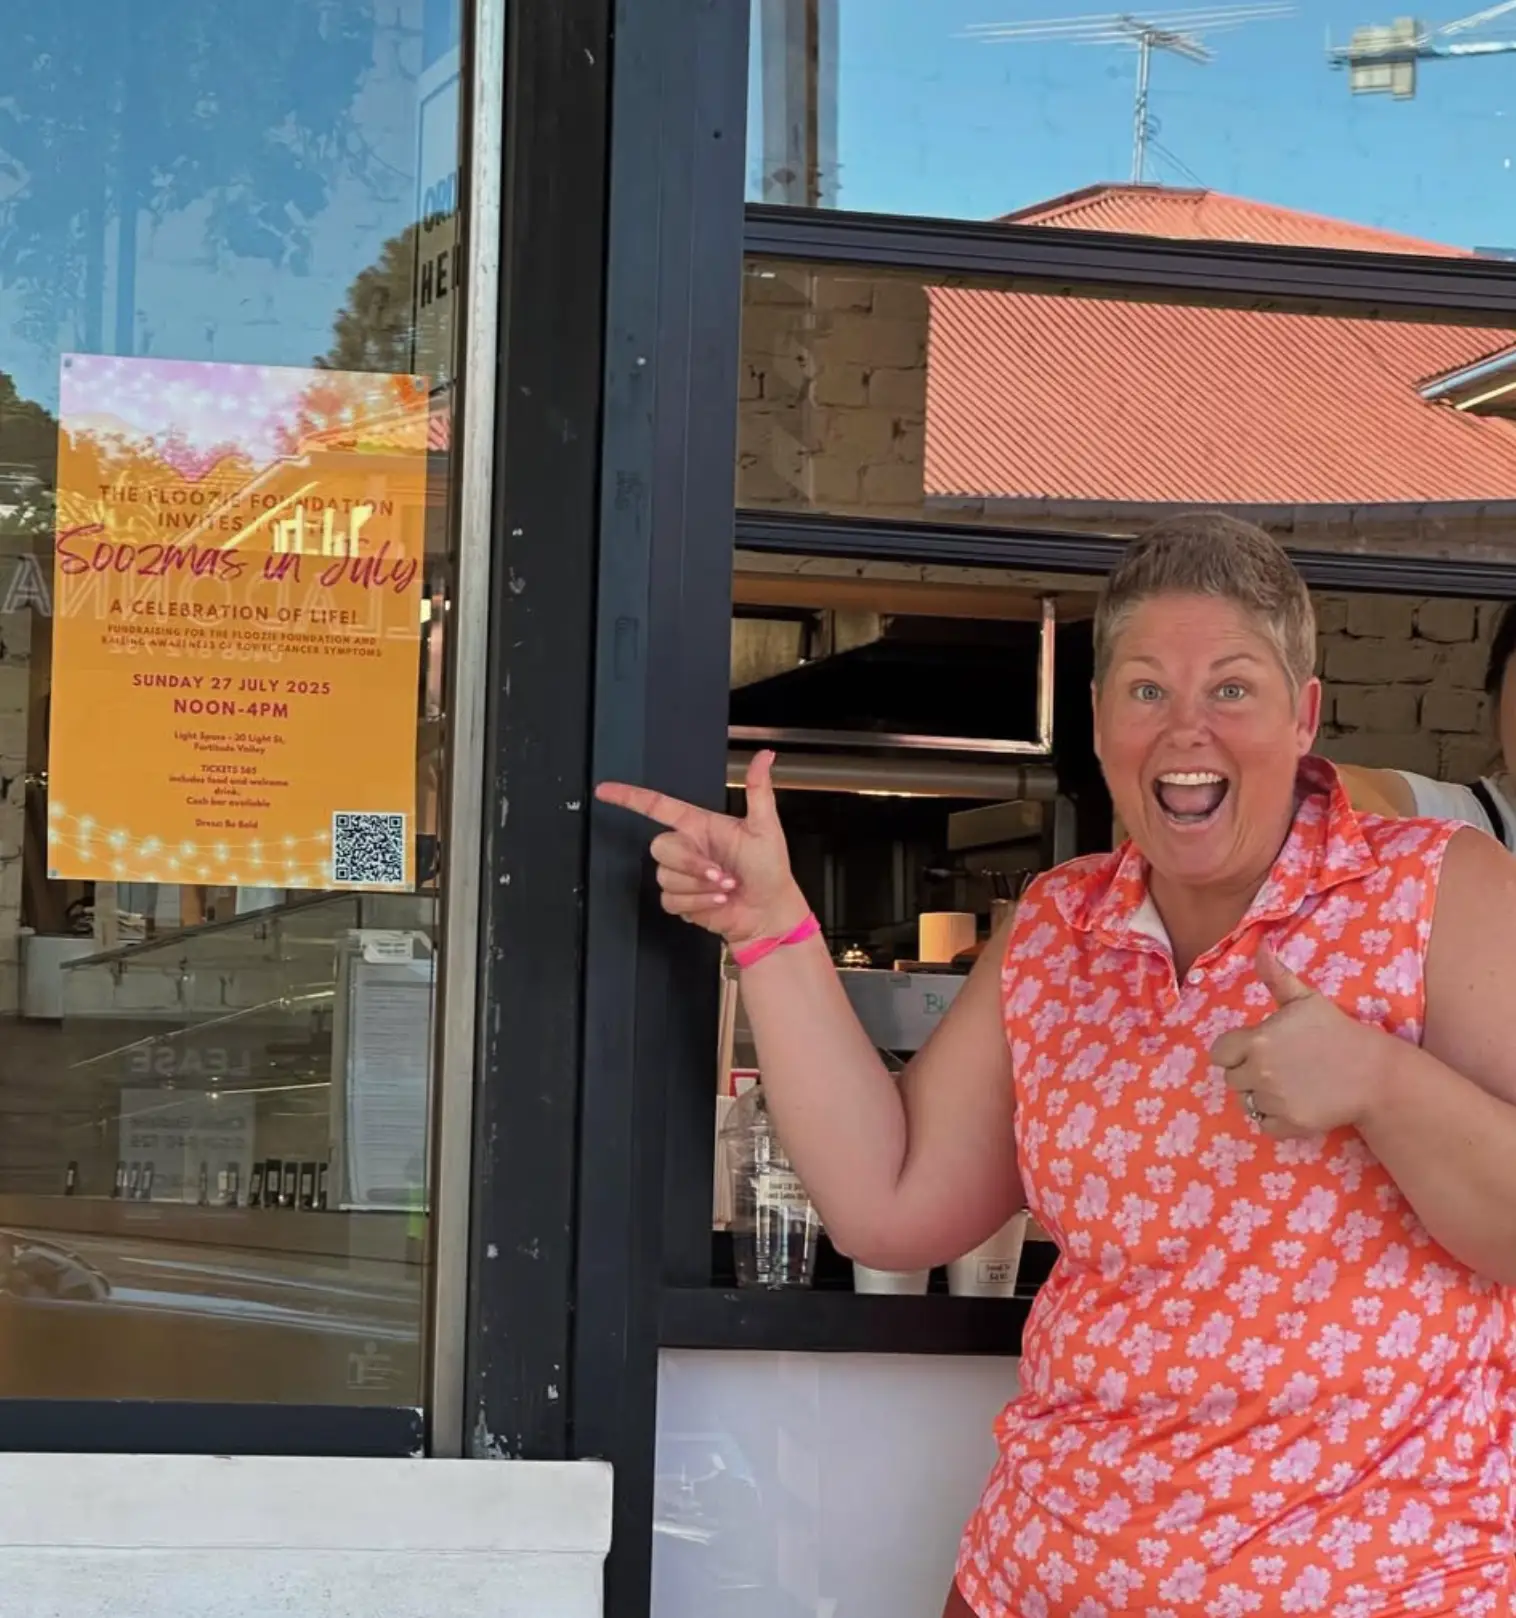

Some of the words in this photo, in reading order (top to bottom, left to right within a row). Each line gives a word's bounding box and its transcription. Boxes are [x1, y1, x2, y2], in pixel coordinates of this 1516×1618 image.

[98, 485, 139, 503] THE
[158, 512, 243, 531] INVES
[109, 599, 122, 614] A
[132, 600, 268, 621] CELEBRATION
[278, 607, 303, 622] OF
[310, 609, 357, 624] LIFE!
[107, 624, 181, 637] FUNDRAISING
[184, 627, 205, 637] FOR
[210, 629, 228, 639] THE
[232, 630, 277, 641] FLOOZIE
[281, 632, 351, 645] FOUNDATION
[354, 636, 377, 646] AND
[149, 638, 216, 650] AWARENESS
[276, 643, 320, 655] CANCER
[323, 645, 383, 658] SYMPTOMS
[132, 673, 204, 689] SUNDAY
[211, 677, 233, 690] 27
[238, 678, 280, 692] JULY
[286, 680, 331, 695] 2025
[173, 698, 289, 719] NOON-4PM
[174, 730, 197, 741] Light
[248, 733, 271, 745] Light
[236, 744, 266, 755] Valley
[200, 764, 238, 774] TICKETS
[186, 796, 209, 806] Cash
[228, 799, 271, 809] available
